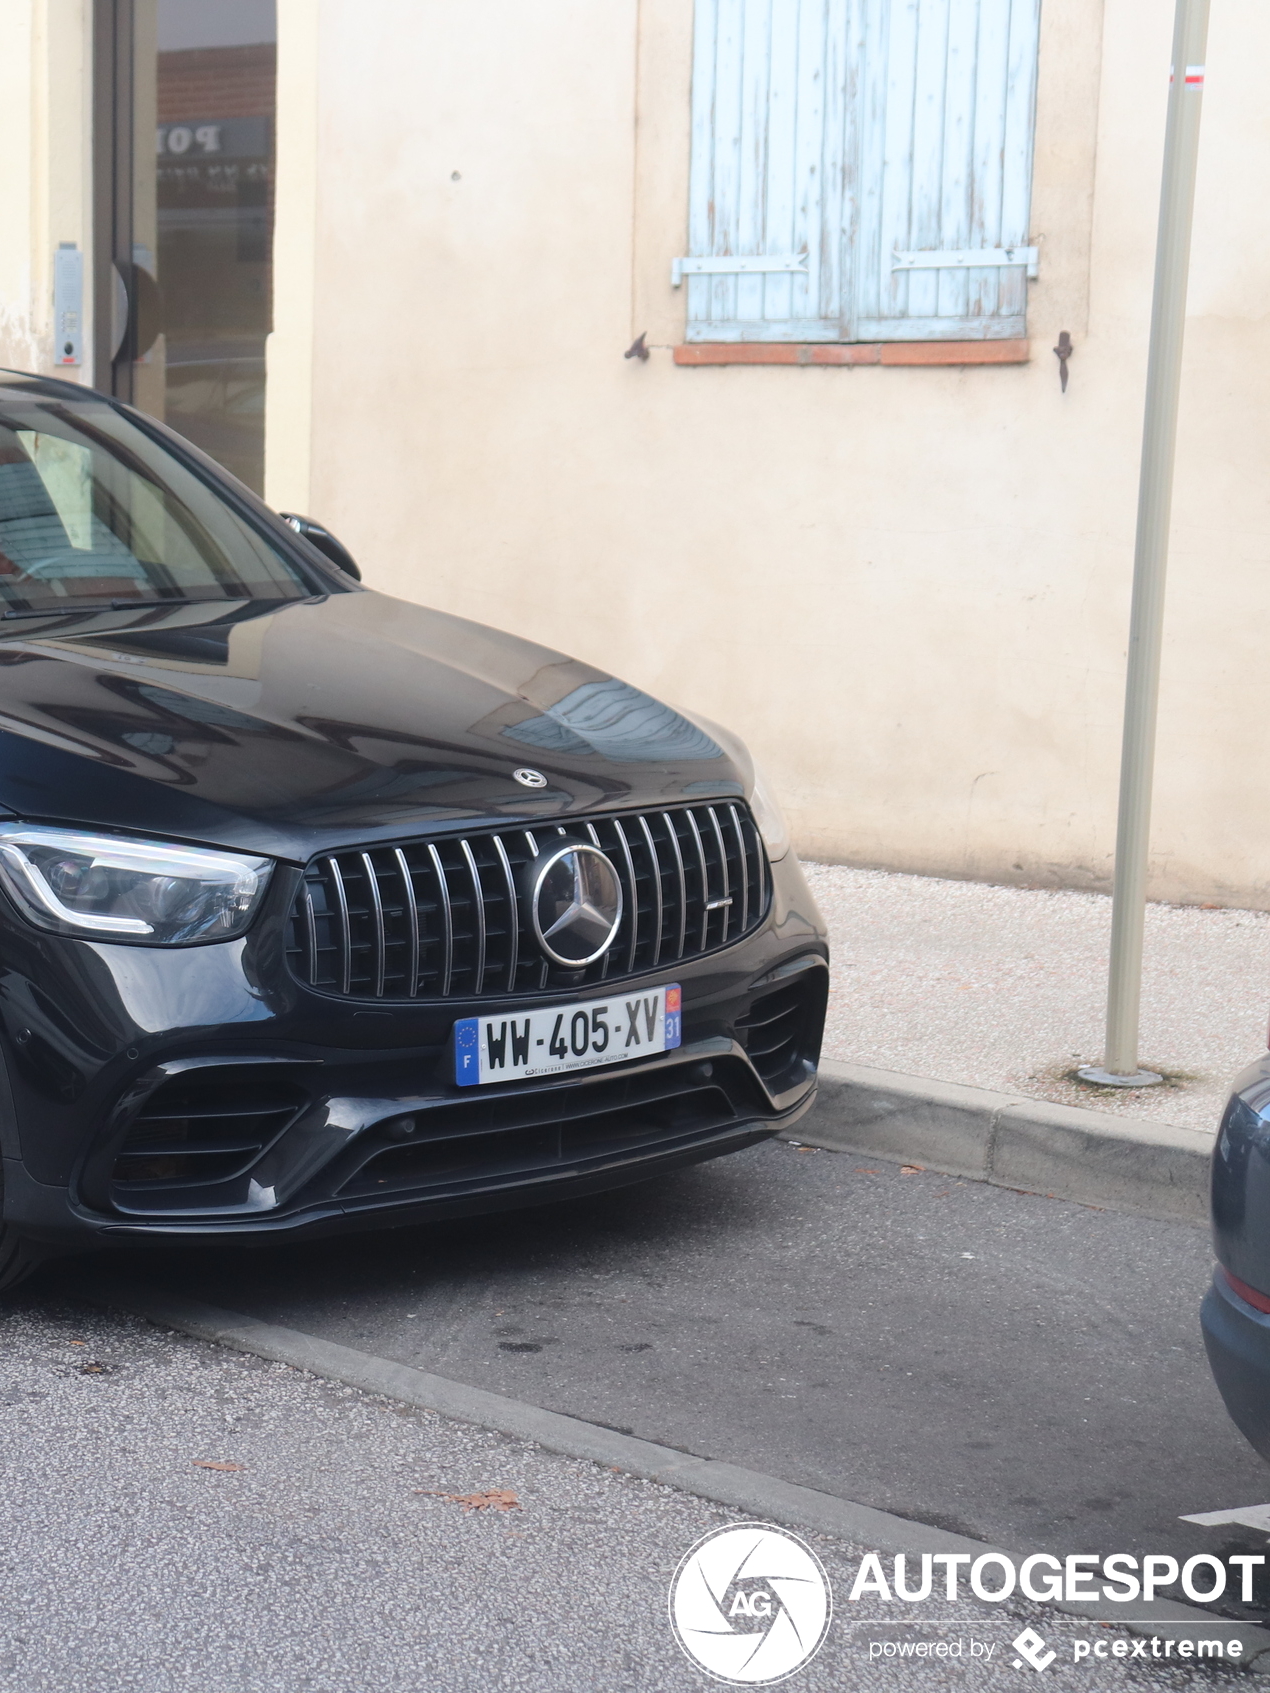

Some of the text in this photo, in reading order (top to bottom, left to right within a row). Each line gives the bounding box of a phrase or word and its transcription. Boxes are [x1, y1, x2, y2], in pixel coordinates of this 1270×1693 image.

[486, 995, 660, 1069] WW-405-XV
[665, 1016, 681, 1040] 31
[463, 1054, 472, 1070] F
